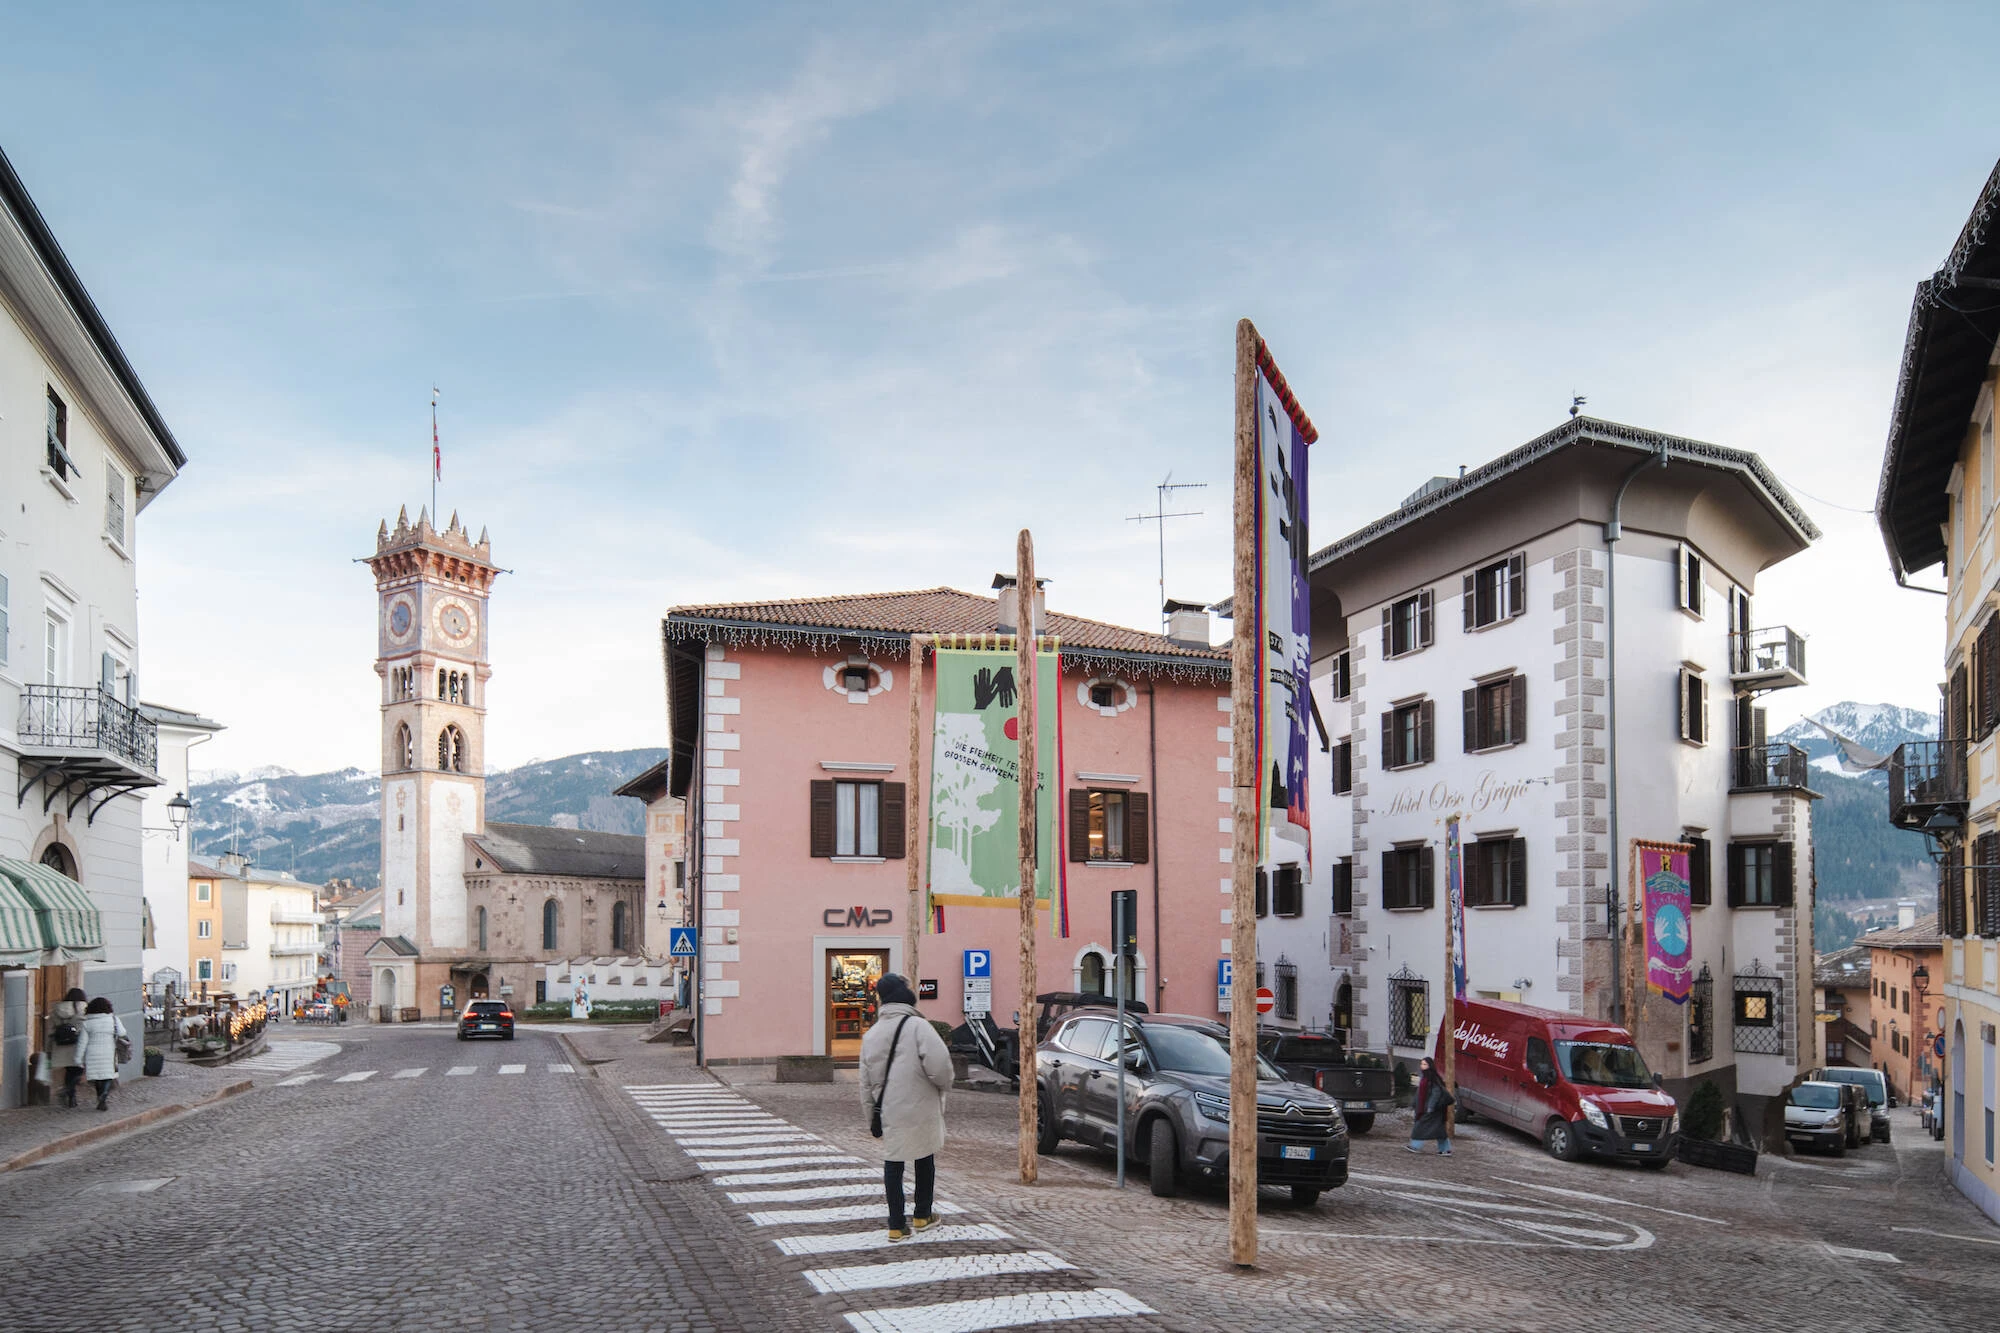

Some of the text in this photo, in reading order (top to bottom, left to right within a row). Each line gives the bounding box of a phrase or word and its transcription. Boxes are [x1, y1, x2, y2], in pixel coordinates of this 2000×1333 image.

[980, 763, 1013, 780] GANZEN
[1382, 785, 1425, 817] Hotel
[1471, 769, 1529, 814] Grigio
[823, 905, 893, 928] CMP
[969, 951, 987, 976] P
[919, 983, 936, 992] MP
[1453, 1019, 1510, 1053] deflorian
